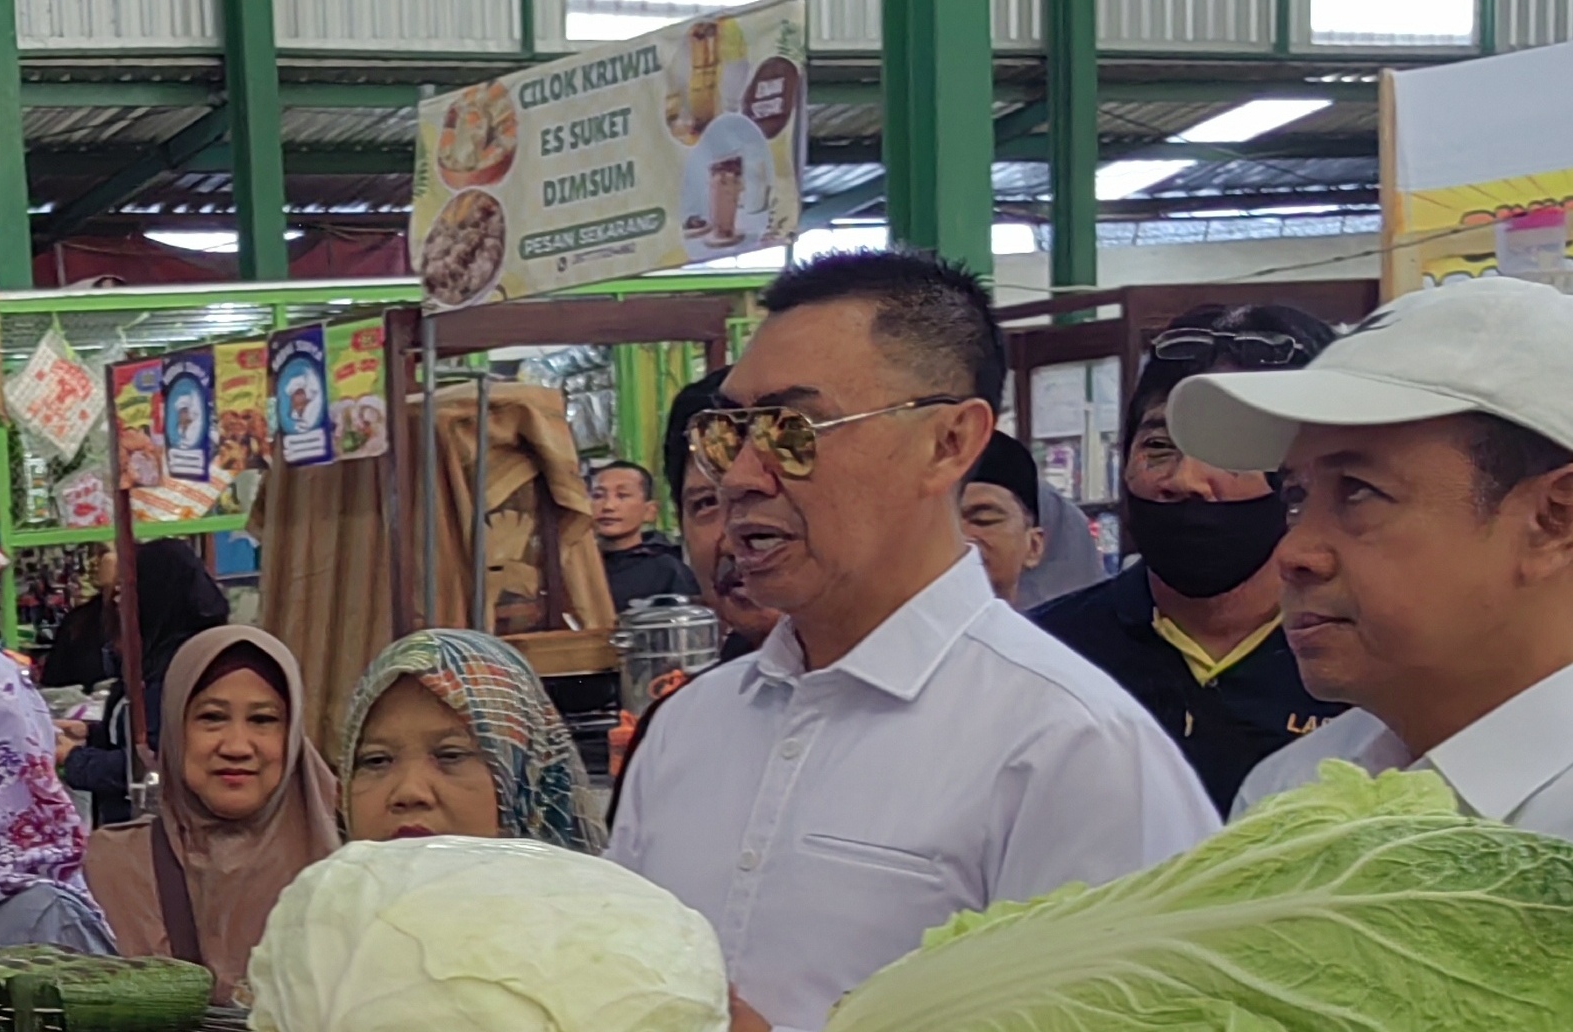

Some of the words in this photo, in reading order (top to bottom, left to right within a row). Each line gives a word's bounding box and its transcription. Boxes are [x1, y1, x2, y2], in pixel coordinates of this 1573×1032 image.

[519, 70, 578, 109] CILOK
[581, 45, 663, 93] KRIWIL
[540, 125, 565, 156] ES
[569, 107, 632, 150] SUKET
[543, 160, 636, 207] DIMSUM
[523, 231, 576, 256] PESAN
[578, 213, 659, 245] SEKARANG
